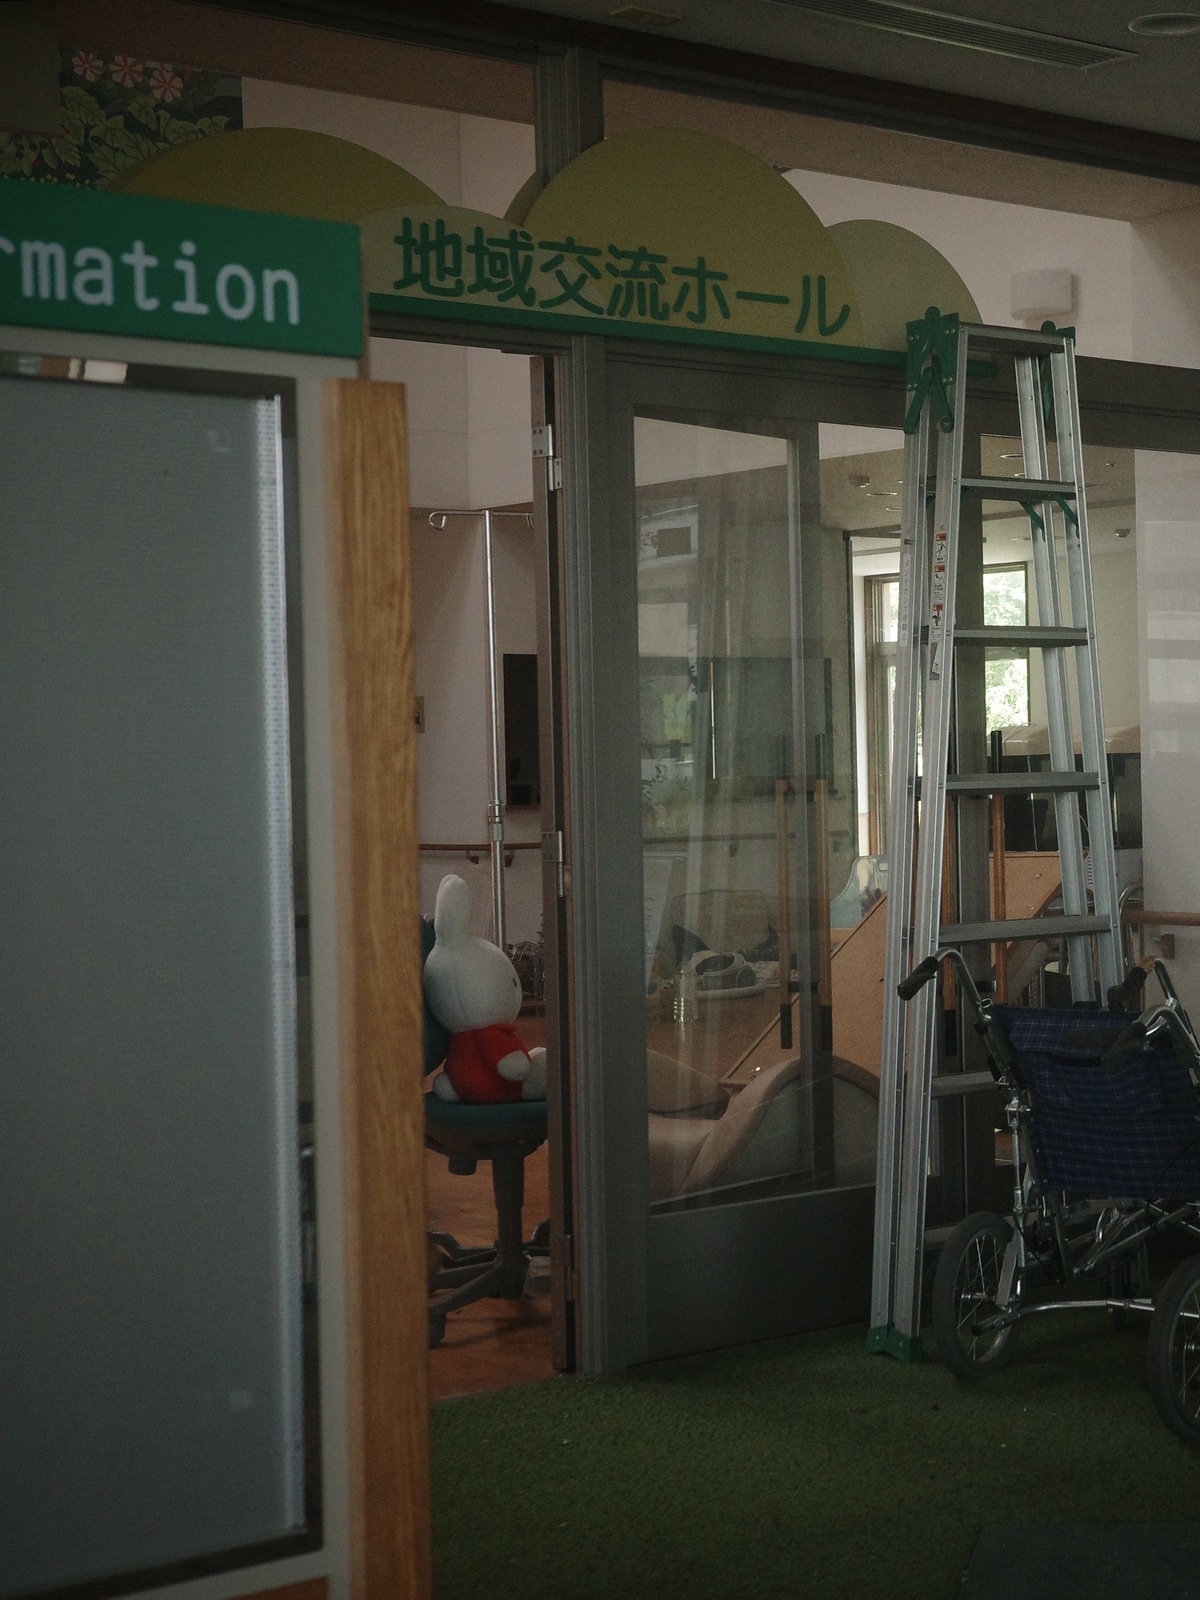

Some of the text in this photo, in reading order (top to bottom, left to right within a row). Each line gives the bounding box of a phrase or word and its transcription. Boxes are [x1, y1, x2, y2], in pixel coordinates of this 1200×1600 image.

[394, 217, 850, 337] 地域交流ホール
